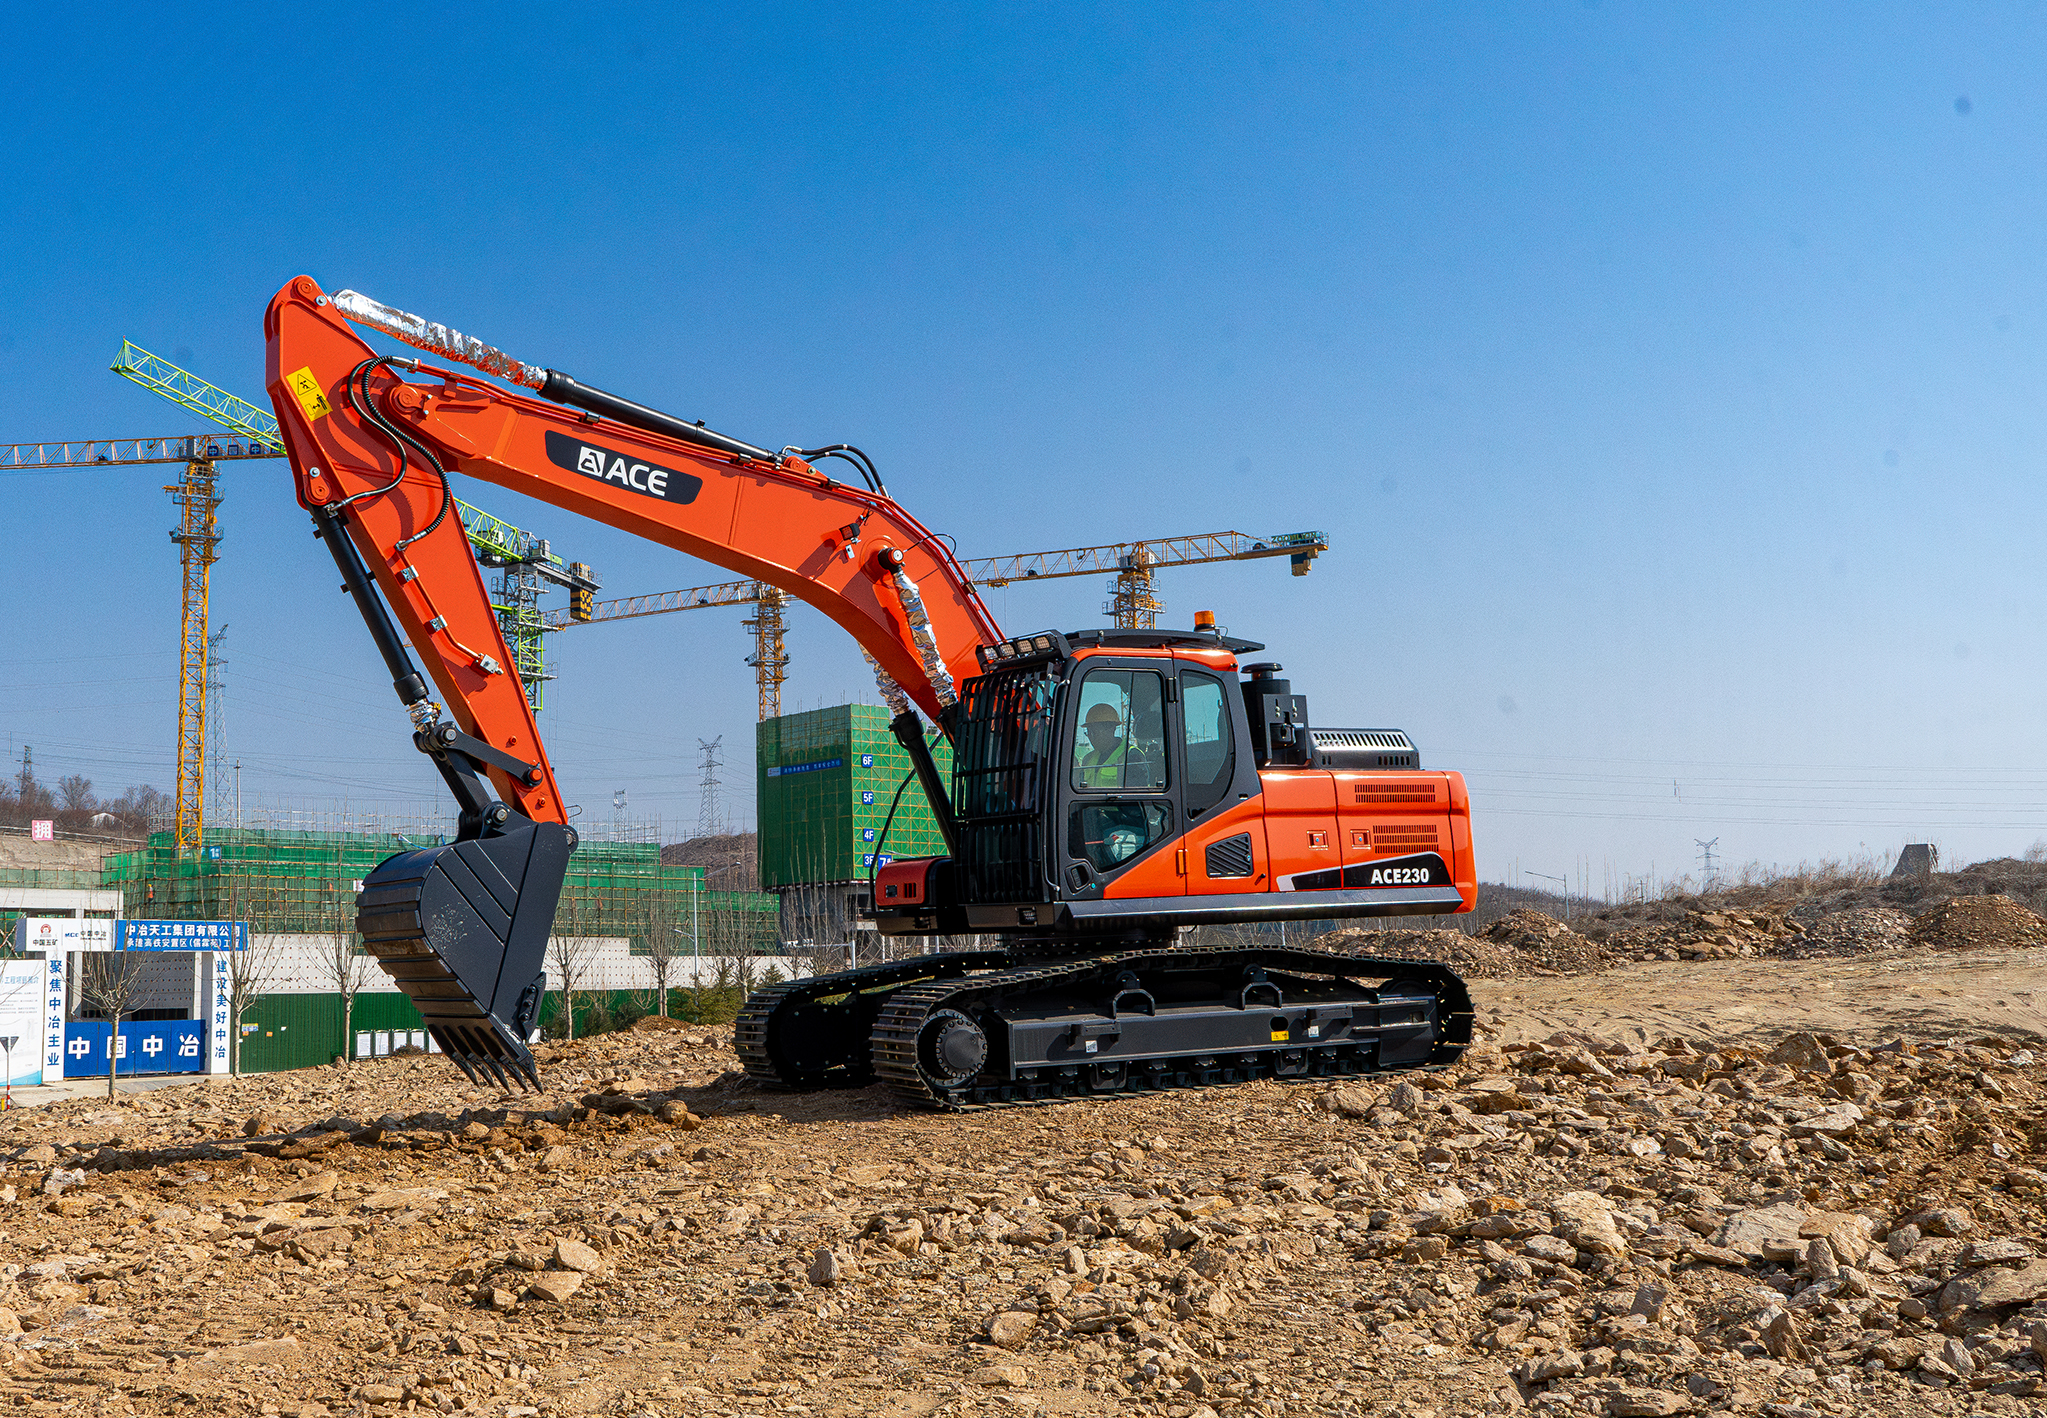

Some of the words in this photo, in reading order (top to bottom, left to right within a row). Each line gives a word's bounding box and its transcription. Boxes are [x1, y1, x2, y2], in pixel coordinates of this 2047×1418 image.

[605, 457, 669, 497] ACE
[862, 756, 872, 766] 6F
[863, 793, 873, 803] 5F
[34, 821, 52, 839] 拥
[864, 830, 874, 840] 4F
[864, 855, 874, 865] 3F
[1370, 868, 1430, 884] ACE230
[125, 924, 240, 937] 中冶天工集团有限公司
[47, 959, 62, 1066] 聚焦中冶主业
[214, 960, 227, 1058] 建设美好中冶
[67, 1033, 200, 1060] 中国中冶
